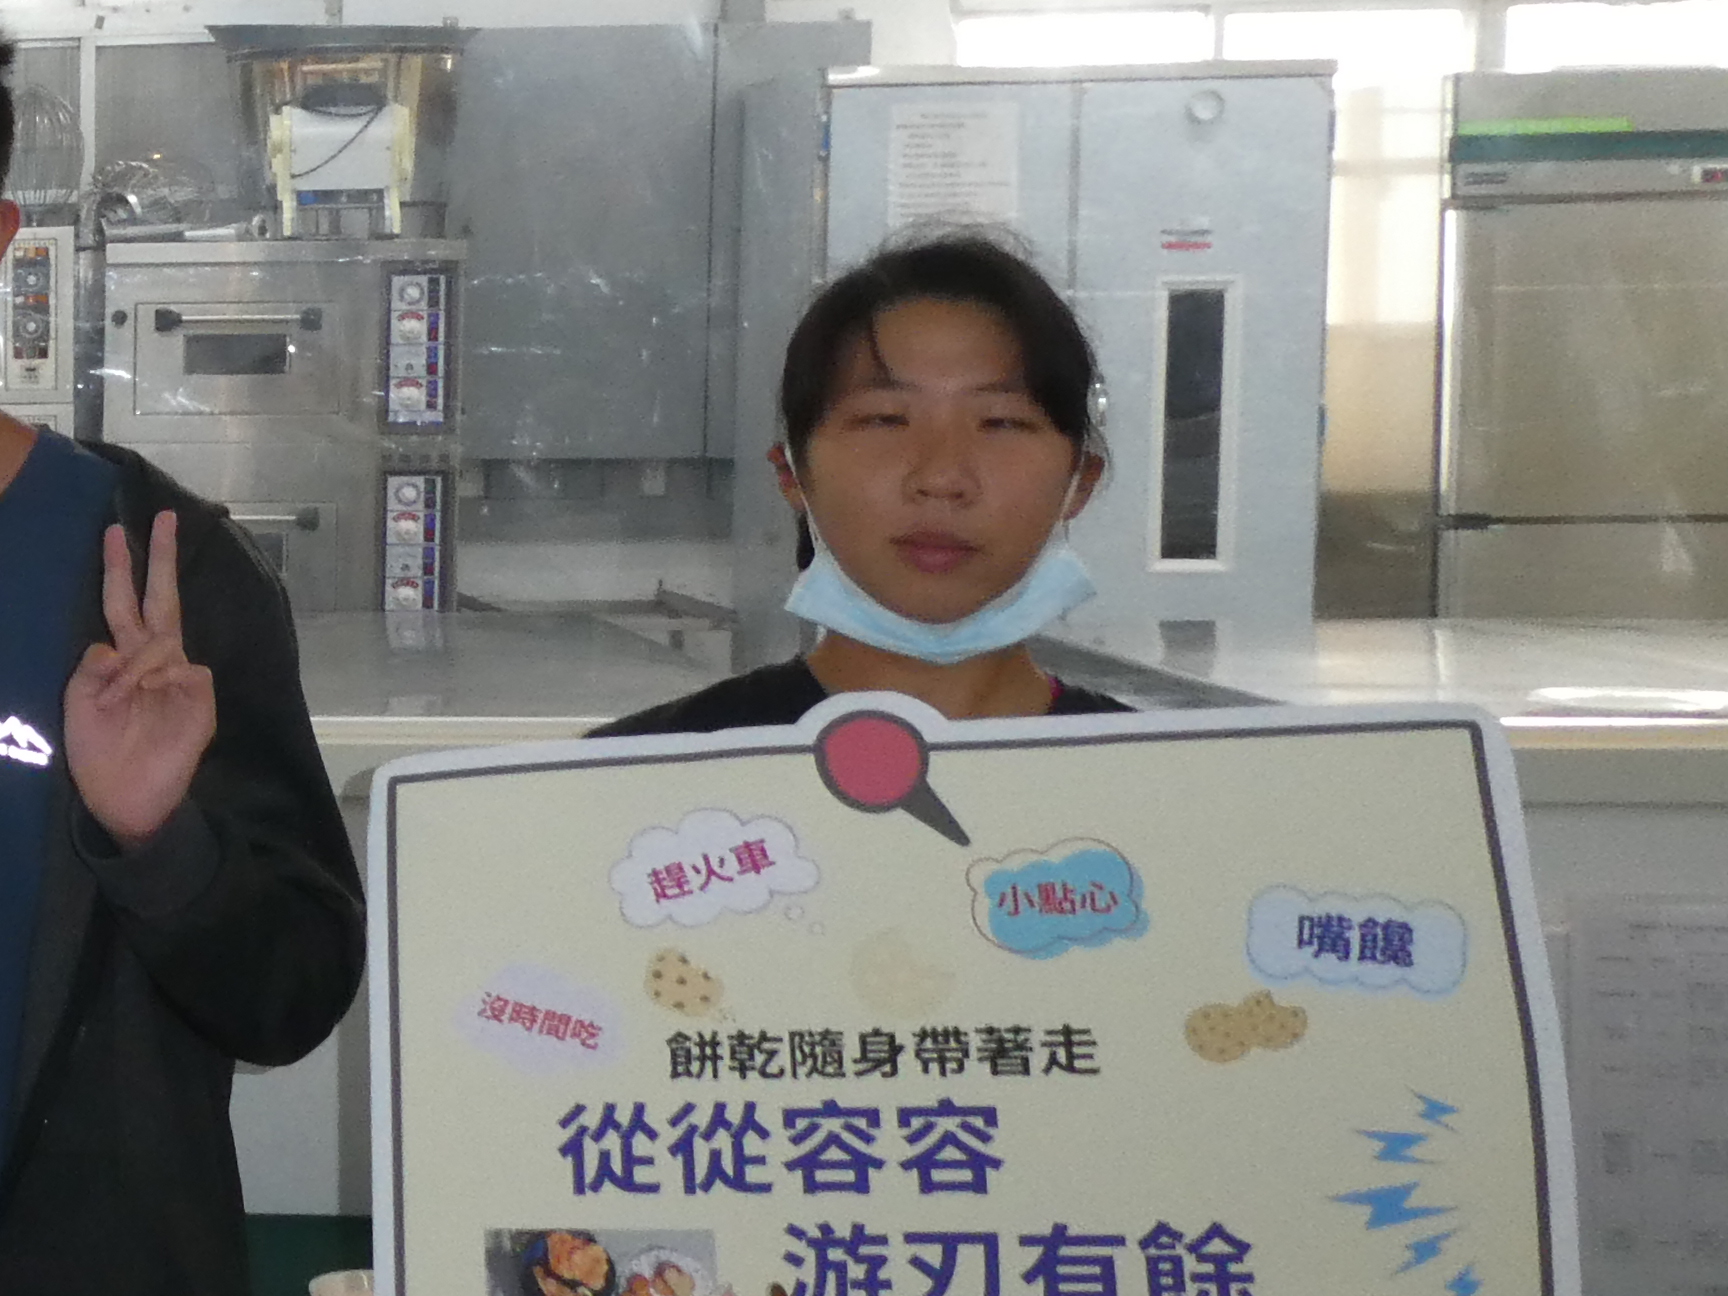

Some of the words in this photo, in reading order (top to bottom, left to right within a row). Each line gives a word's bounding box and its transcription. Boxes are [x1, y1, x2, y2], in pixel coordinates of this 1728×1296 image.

[647, 838, 776, 903] 趕火車
[997, 881, 1119, 917] 小點心
[665, 1024, 1101, 1080] 餅乾隨身帶著走
[556, 1098, 1005, 1196] 從從容容
